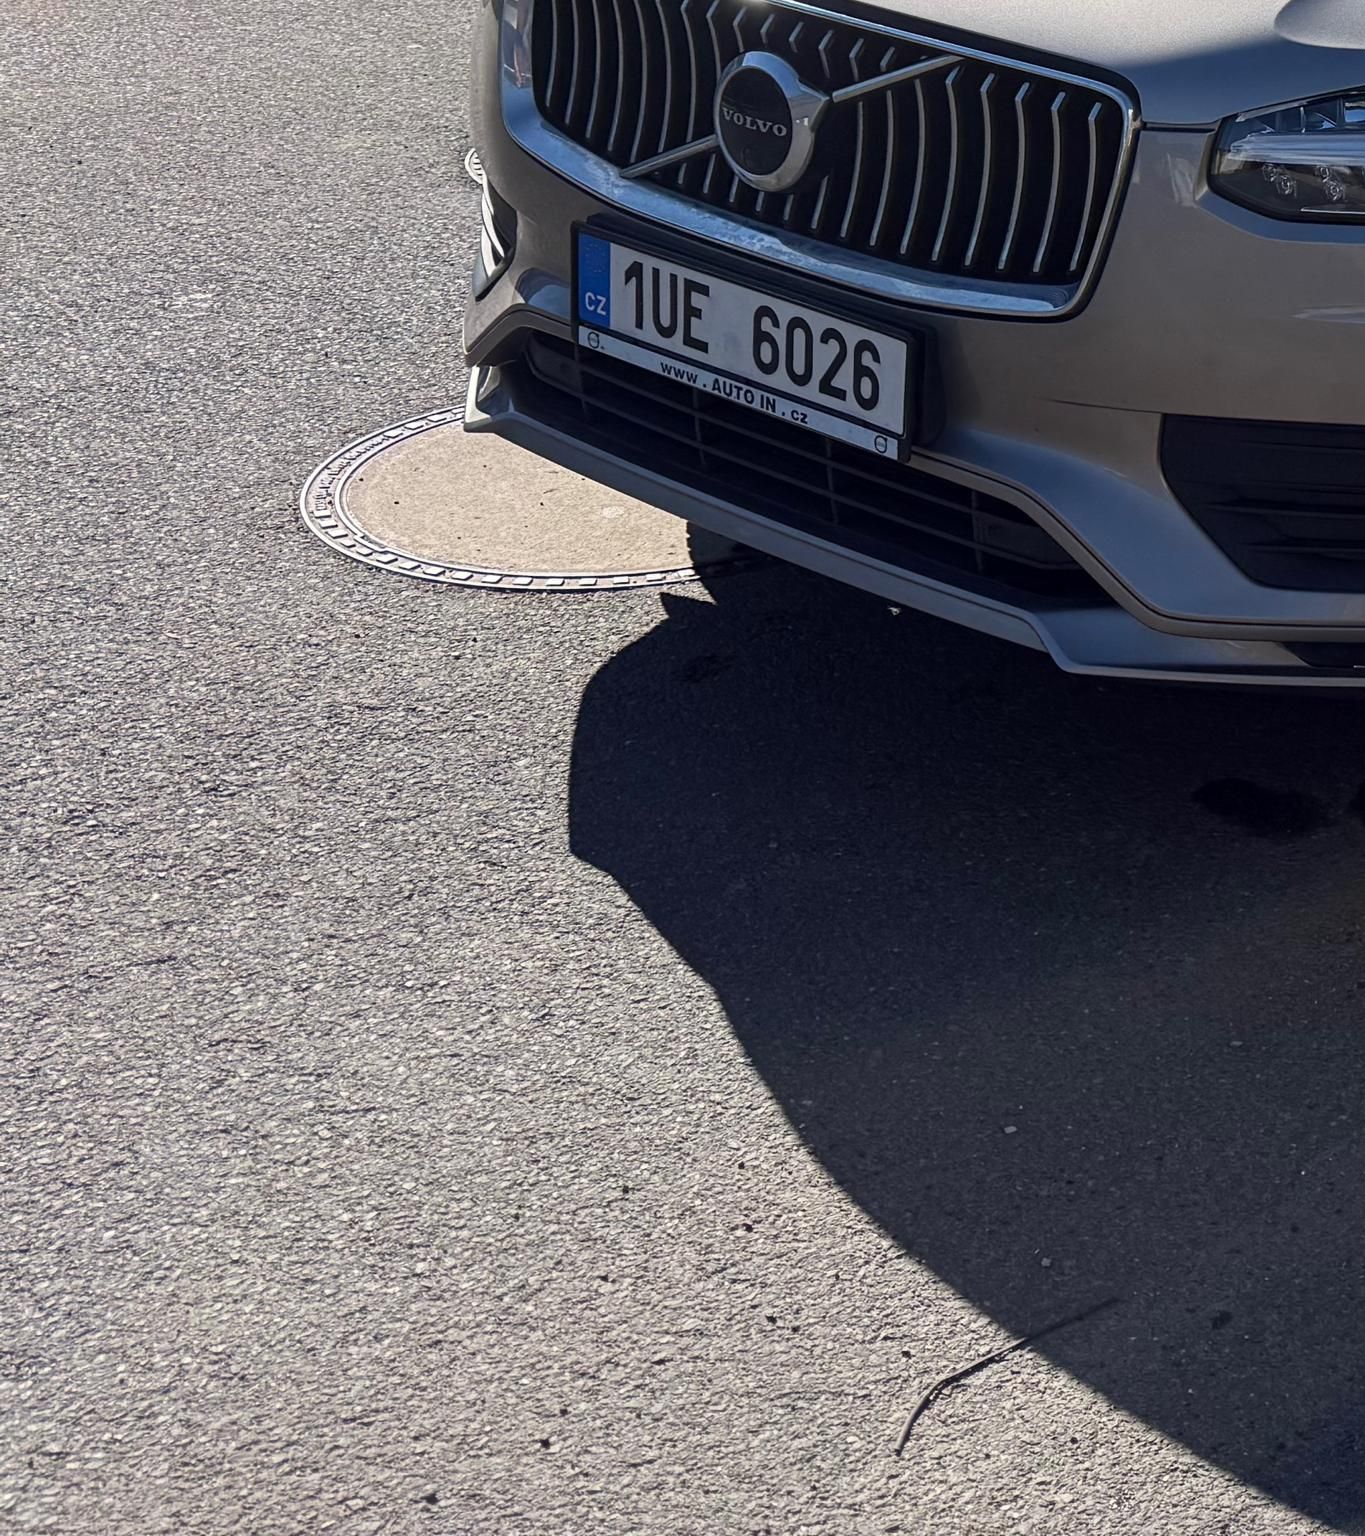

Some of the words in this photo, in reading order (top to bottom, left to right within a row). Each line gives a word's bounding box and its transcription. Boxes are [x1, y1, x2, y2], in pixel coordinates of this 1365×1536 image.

[721, 107, 787, 137] VOLVO
[584, 291, 607, 316] CZ
[623, 260, 710, 354] 1UE
[752, 305, 881, 411] 6026
[711, 377, 755, 405] AUTO
[759, 393, 777, 413] IN
